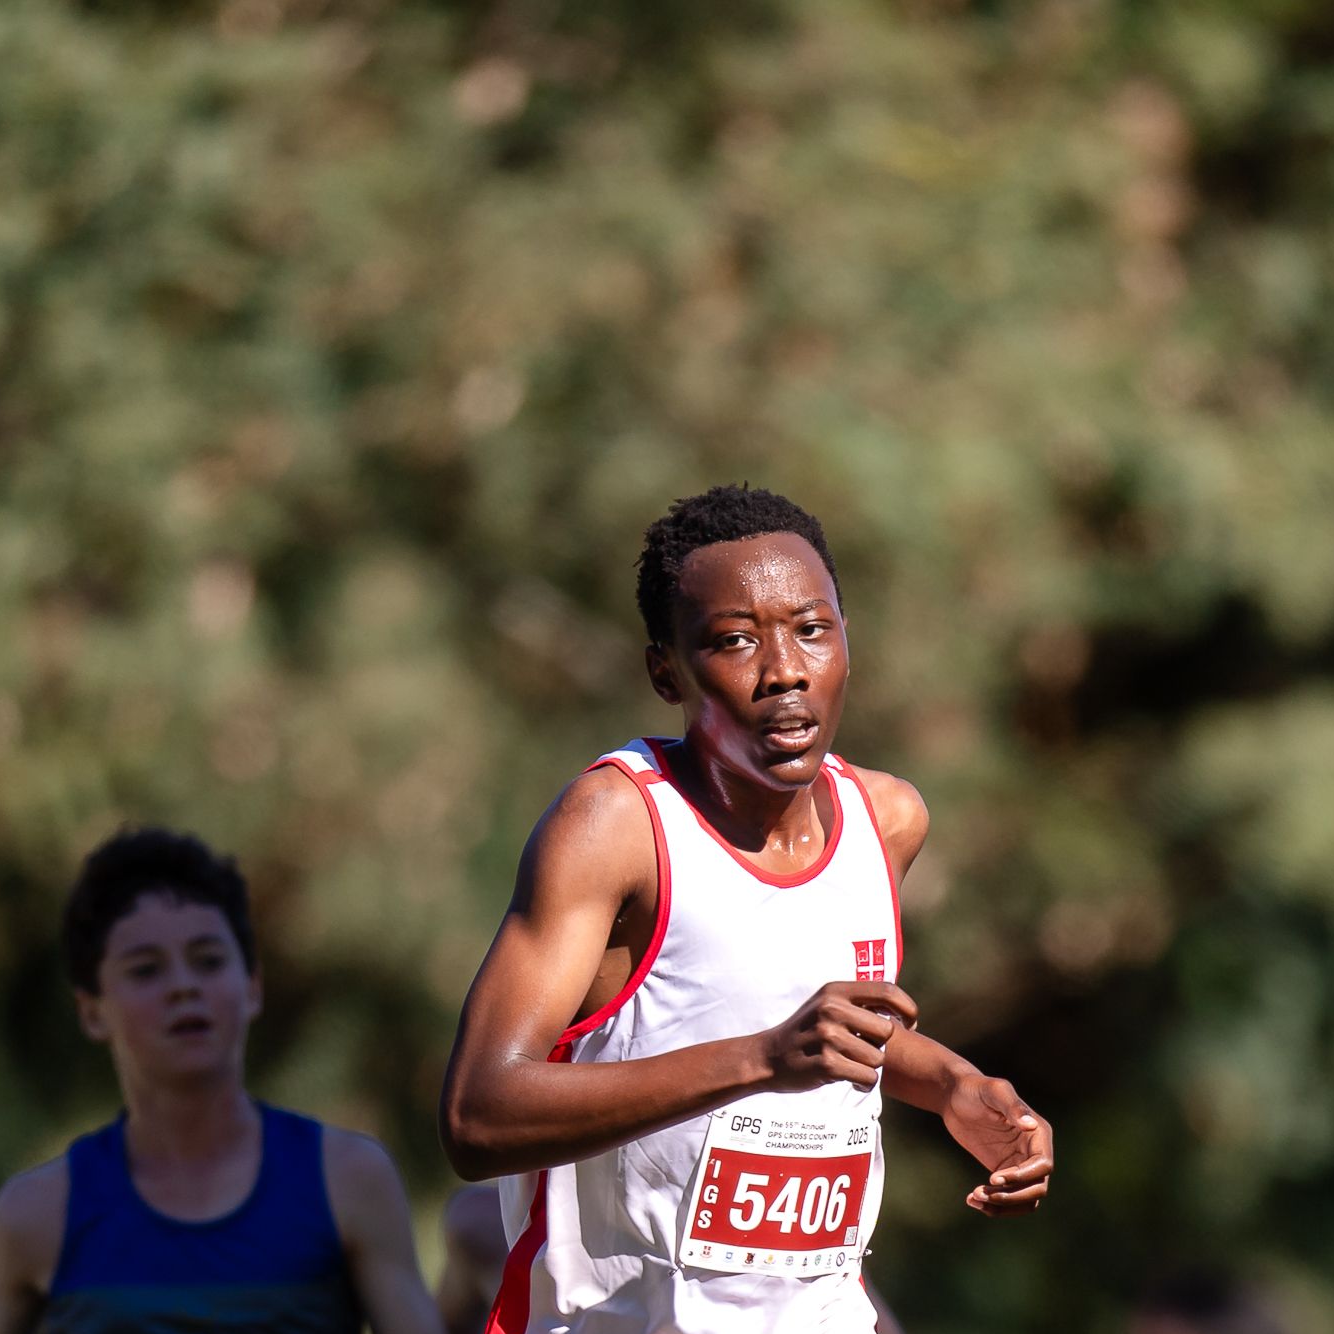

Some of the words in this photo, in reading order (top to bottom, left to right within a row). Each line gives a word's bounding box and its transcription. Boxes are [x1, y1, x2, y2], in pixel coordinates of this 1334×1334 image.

[730, 1115, 763, 1135] GPS
[770, 1120, 784, 1128] The
[801, 1123, 826, 1131] Annual
[767, 1131, 783, 1139] GPS
[784, 1132, 807, 1140] CROSS
[808, 1133, 838, 1141] COUNTRY
[846, 1126, 869, 1146] 2025
[765, 1141, 824, 1151] CHAMPIONSHIPS
[729, 1171, 851, 1235] 5406
